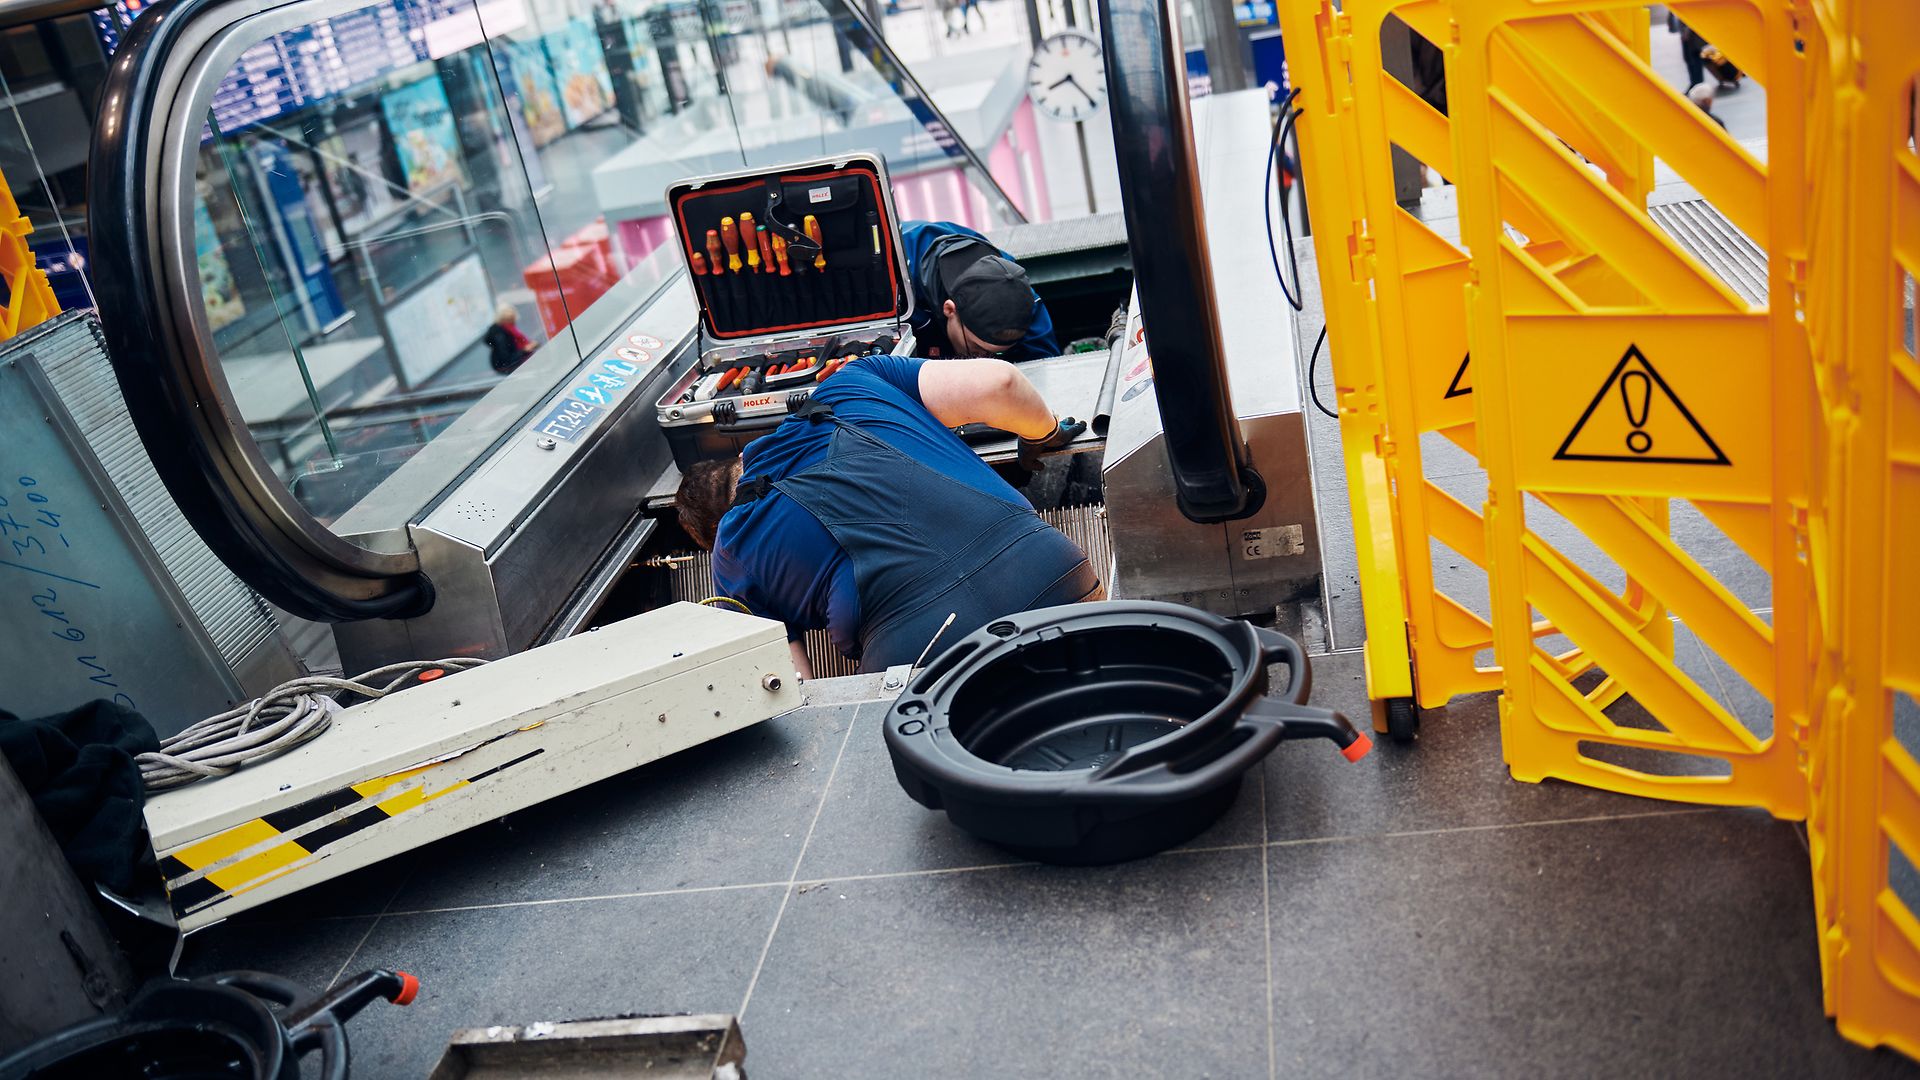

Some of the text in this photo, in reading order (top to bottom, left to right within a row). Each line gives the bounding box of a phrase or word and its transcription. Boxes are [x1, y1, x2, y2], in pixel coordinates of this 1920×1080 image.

[743, 396, 772, 408] HOLEX
[542, 402, 594, 439] FT.24.2
[1246, 545, 1262, 557] CE
